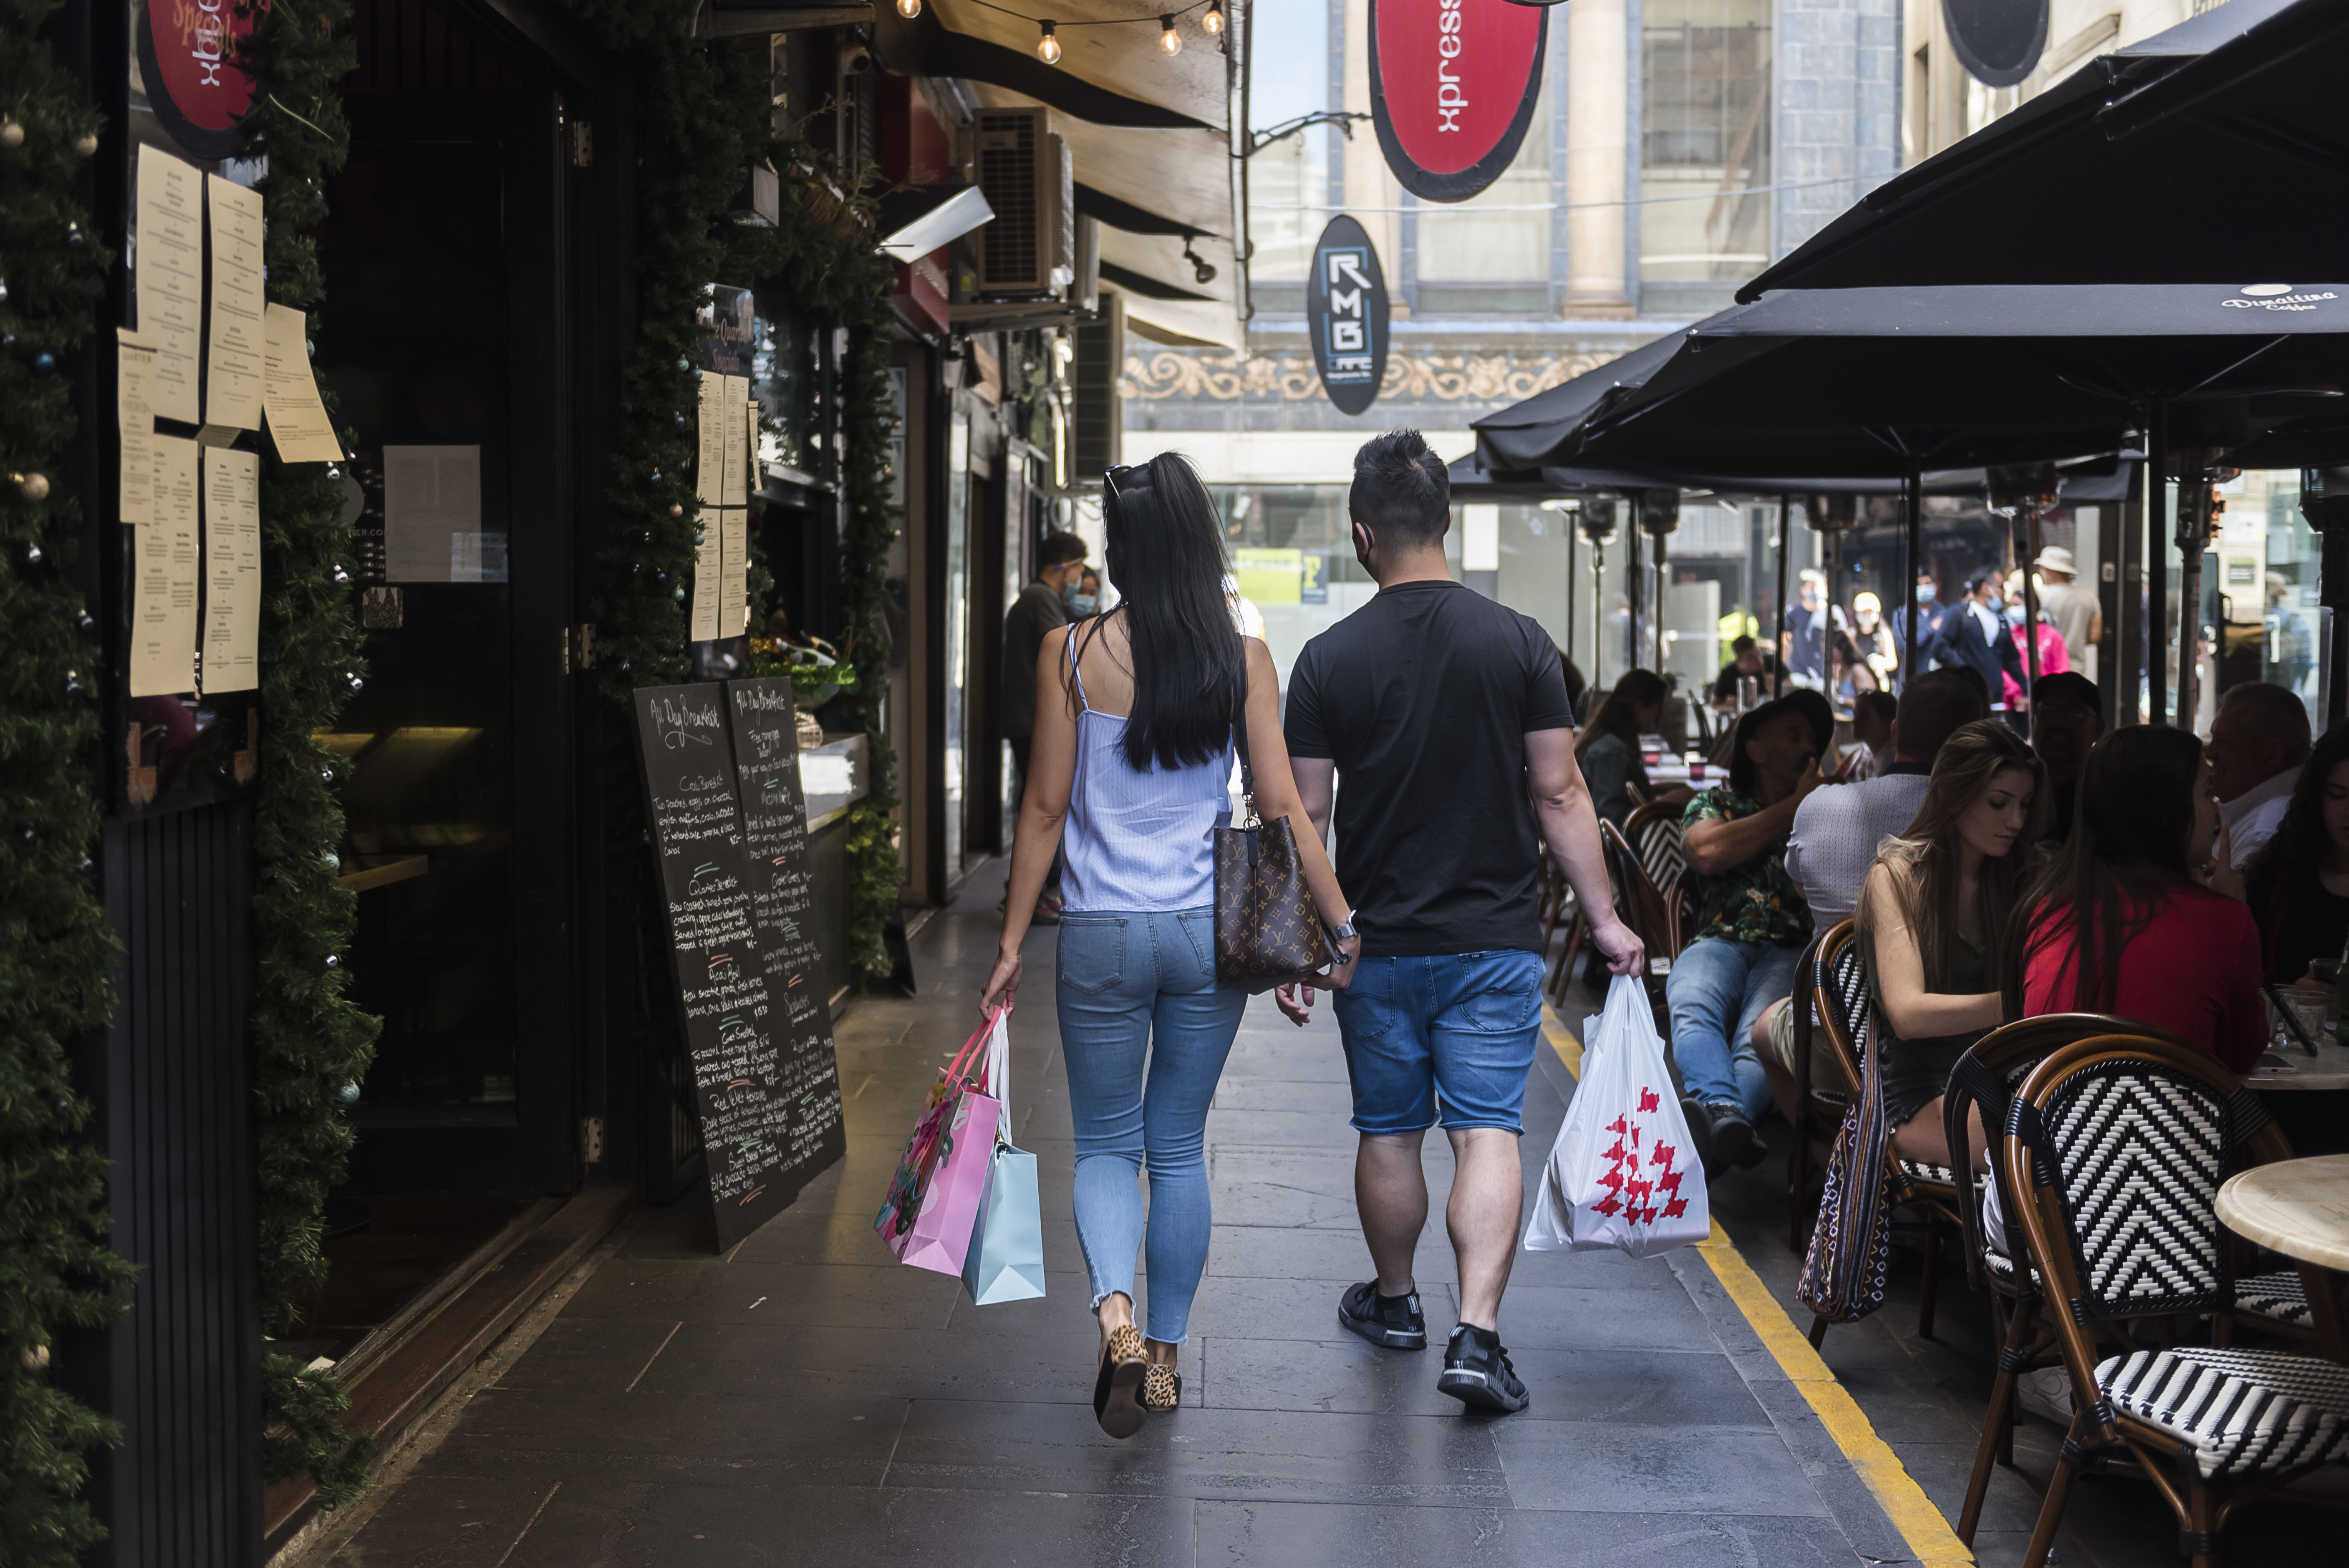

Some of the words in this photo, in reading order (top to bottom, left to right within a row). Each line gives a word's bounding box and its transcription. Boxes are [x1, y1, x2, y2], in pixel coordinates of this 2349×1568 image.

[2221, 292, 2338, 308] Dimattina
[712, 348, 740, 373] Specials
[736, 690, 747, 717] All
[747, 690, 761, 726] Day
[757, 685, 785, 713] Breakfast
[651, 698, 665, 737] All
[664, 698, 685, 748] Day
[679, 693, 720, 729] Breakfast
[772, 729, 780, 749] eggs
[679, 776, 700, 792] Crab
[698, 769, 723, 790] Benedict
[653, 797, 665, 811] Two
[665, 798, 688, 815] poached
[689, 797, 703, 811] eggs
[712, 789, 734, 803] charcoal
[715, 805, 734, 818] avocado
[723, 822, 736, 833] black
[747, 832, 761, 845] fresh
[689, 879, 716, 896] Quarter
[714, 874, 738, 891] Benedict
[683, 897, 707, 912] roasted
[705, 895, 723, 912] pulled
[734, 890, 751, 910] crunchy
[698, 914, 712, 928] apple
[711, 912, 723, 921] cider
[735, 917, 748, 928] muffin
[676, 939, 697, 953] topped
[703, 938, 719, 955] green
[709, 968, 727, 987] Acai
[727, 963, 741, 983] Bowl
[683, 989, 696, 1003] Acai
[737, 979, 748, 993] fresh
[748, 977, 763, 989] berries
[738, 995, 754, 1007] toasted
[752, 989, 769, 1002] almonds
[735, 1023, 757, 1040] Smashed
[691, 1049, 701, 1060] Two
[701, 1044, 720, 1061] poached
[722, 1045, 735, 1059] free
[747, 1039, 759, 1058] eggs
[731, 1054, 750, 1068] topped
[709, 1094, 730, 1111] Red
[728, 1089, 744, 1107] Velvet
[745, 1086, 767, 1104] Hotcakes
[719, 1112, 734, 1125] stack
[734, 1106, 739, 1119] of
[704, 1130, 720, 1141] fresh
[705, 1139, 724, 1152] topped
[728, 1152, 745, 1172] Sweet
[725, 1168, 747, 1187] avocado
[714, 1195, 720, 1203] 2
[742, 1177, 755, 1190] eggs
